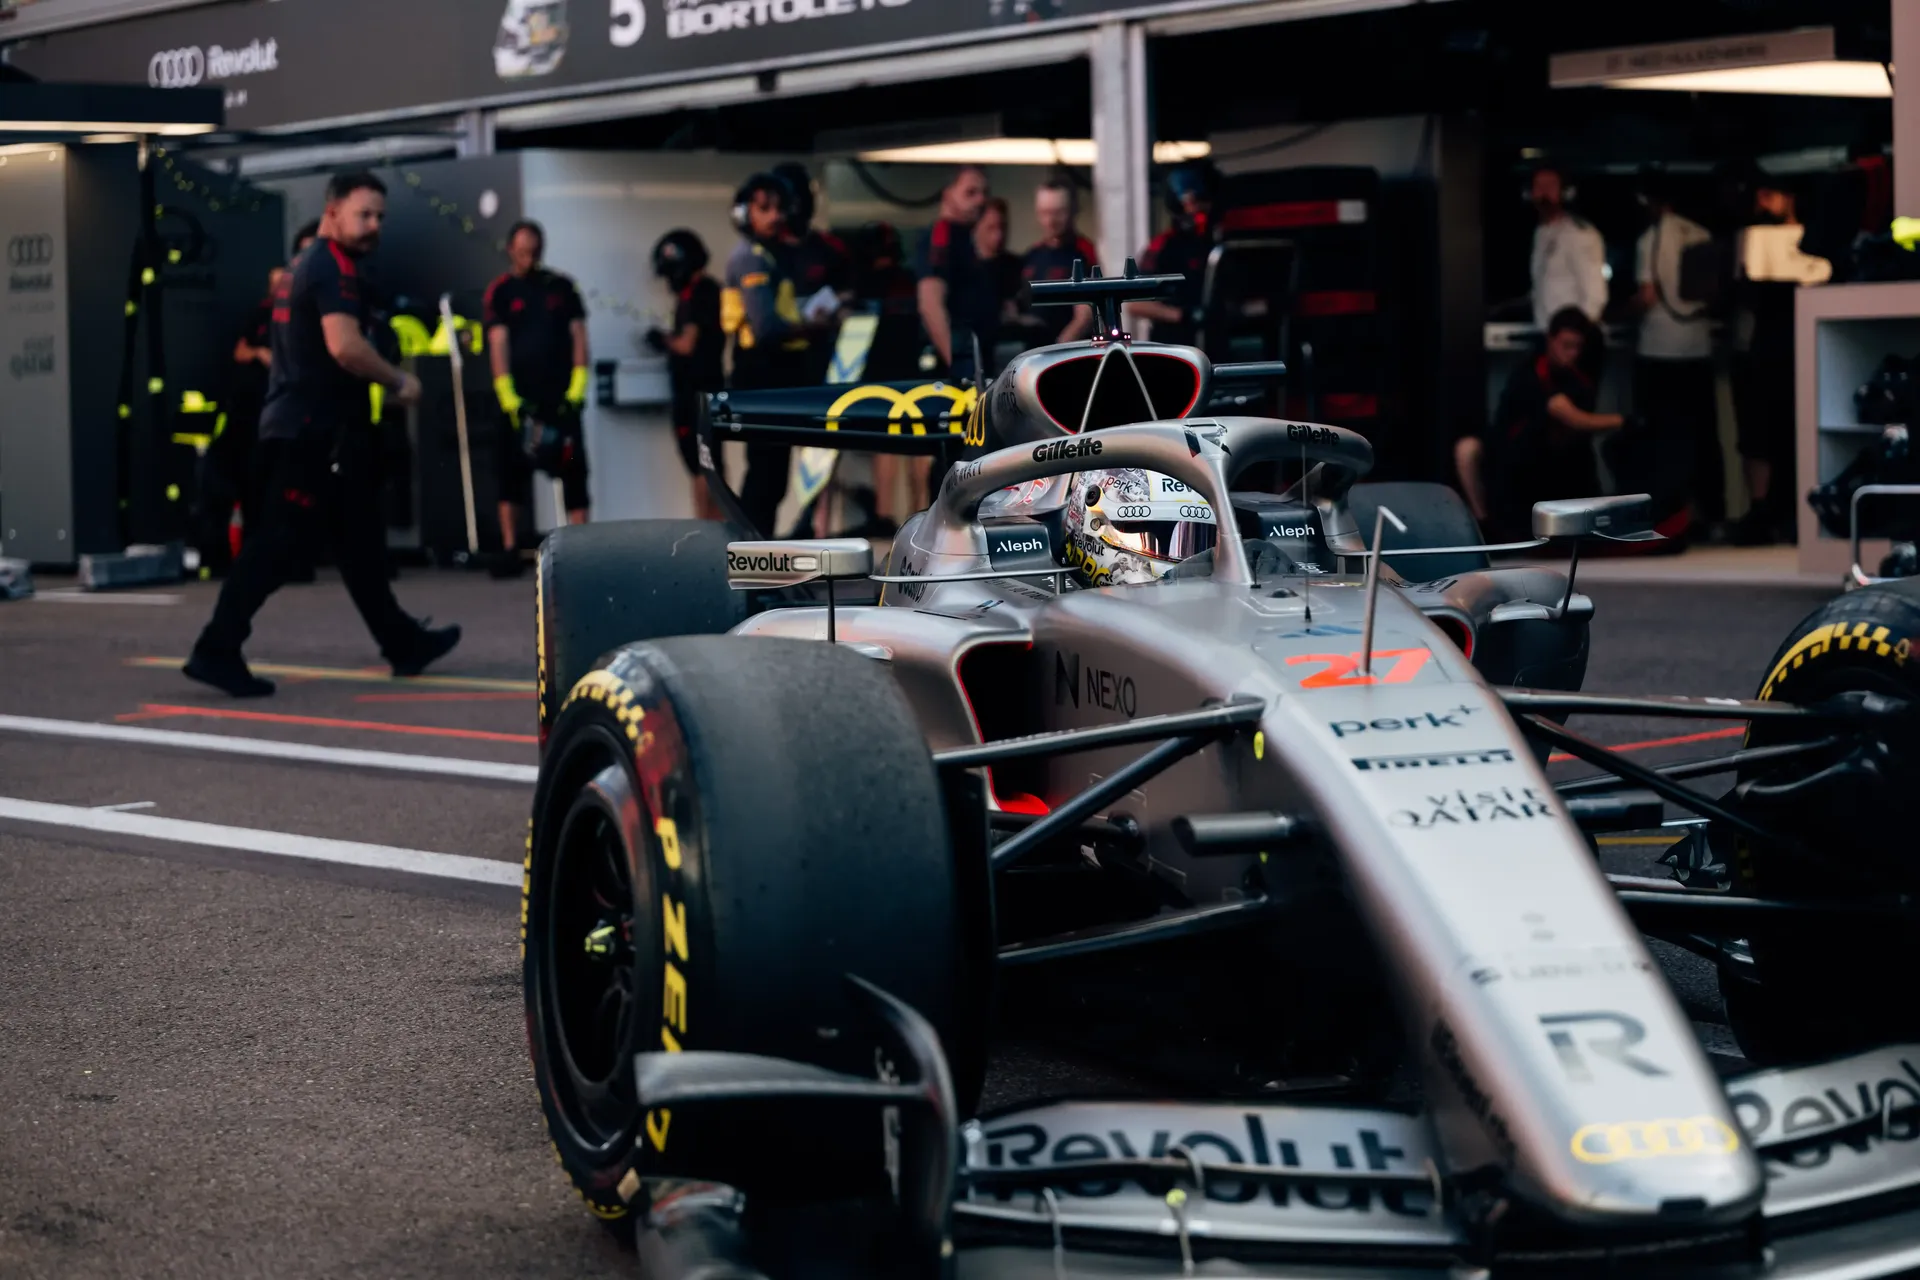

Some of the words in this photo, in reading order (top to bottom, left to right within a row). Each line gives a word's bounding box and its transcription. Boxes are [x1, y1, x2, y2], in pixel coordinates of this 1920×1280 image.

[609, 0, 646, 47] 5
[1286, 424, 1341, 446] Gillette
[1032, 437, 1103, 463] Gillette
[1269, 523, 1315, 538] Aleph
[996, 538, 1043, 553] Aleph
[1074, 533, 1105, 556] Revolut
[727, 552, 790, 572] Revolut
[1284, 647, 1433, 689] 27
[1086, 666, 1137, 718] NEXO
[1350, 748, 1515, 771] PIRELLI
[1426, 787, 1543, 806] visit
[1386, 801, 1560, 829] QATAR
[655, 816, 682, 870] P
[646, 893, 689, 1153] ZEO
[1537, 1010, 1672, 1083] R
[985, 1113, 1427, 1217] Revolut
